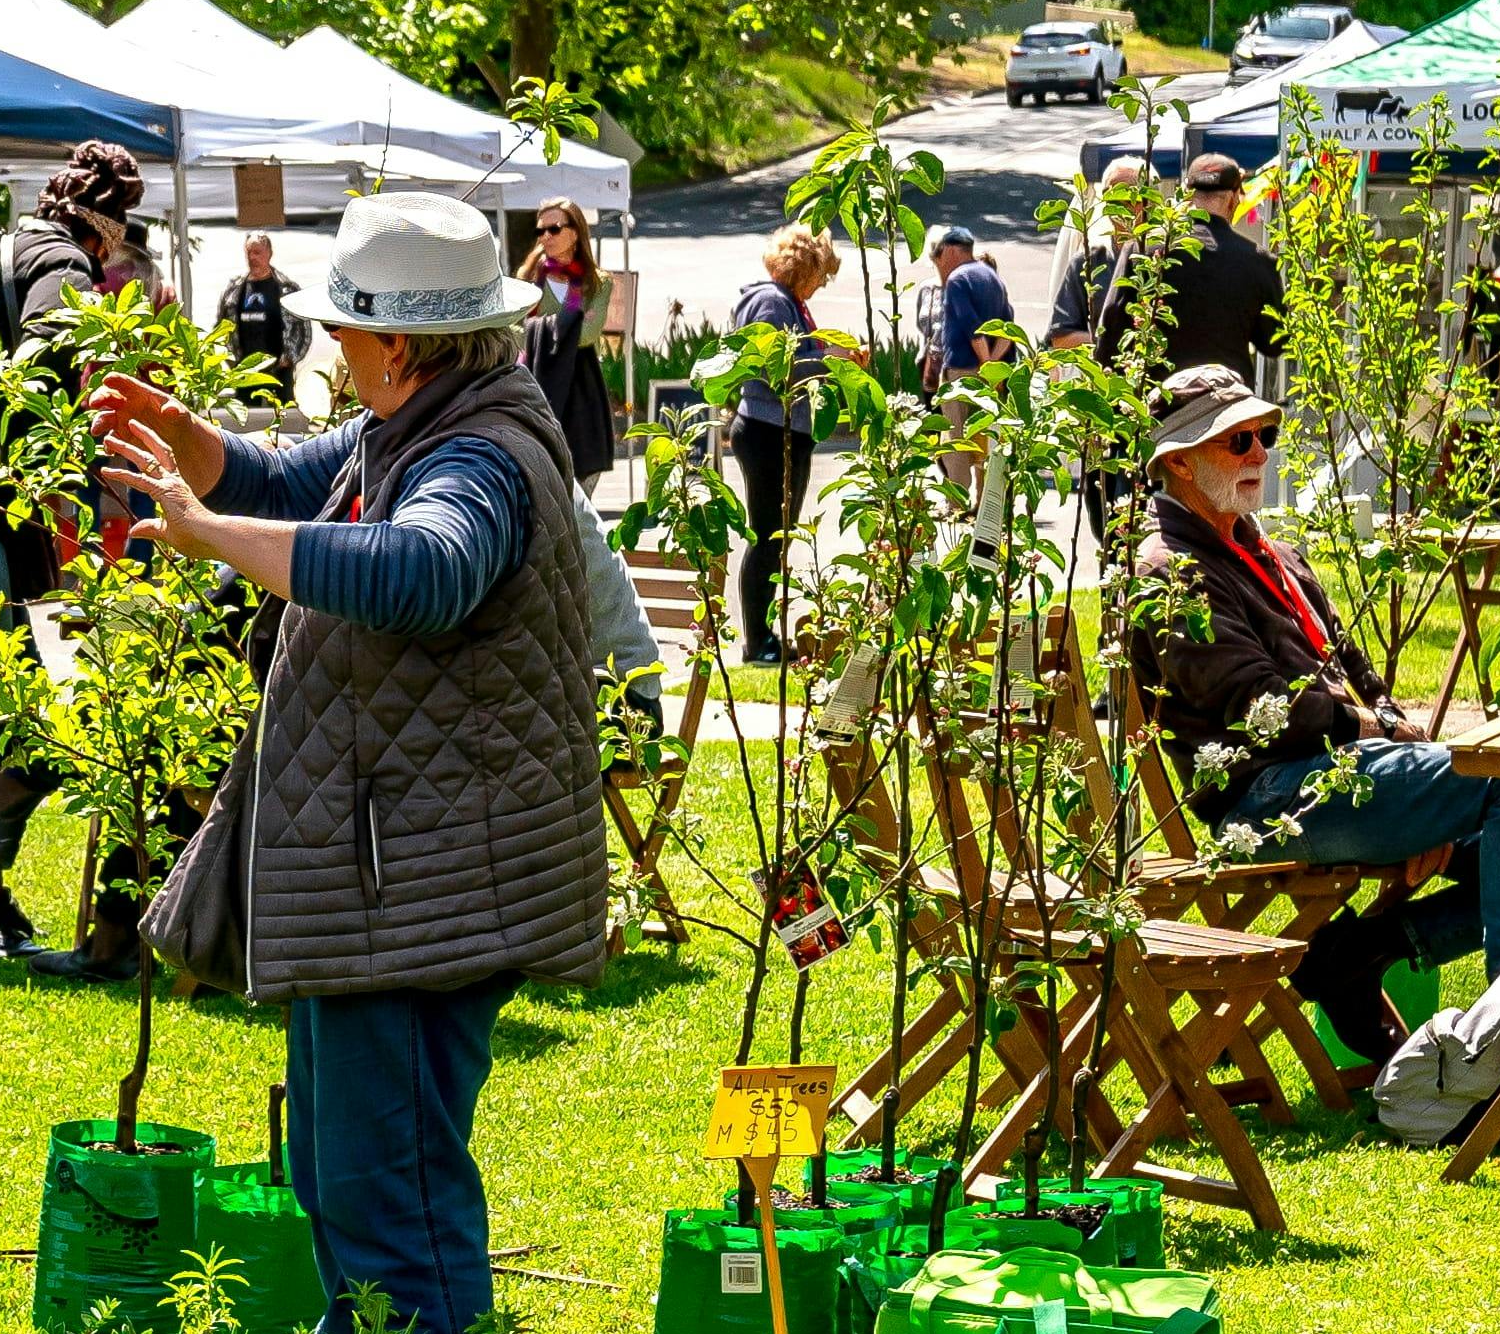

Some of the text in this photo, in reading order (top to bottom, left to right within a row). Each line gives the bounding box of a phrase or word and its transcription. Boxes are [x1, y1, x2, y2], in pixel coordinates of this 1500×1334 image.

[1321, 128, 1362, 141] HALF
[1367, 128, 1378, 141] A
[776, 1074, 828, 1095] Trees
[749, 1095, 799, 1120] $50
[716, 1119, 798, 1145] M $45
